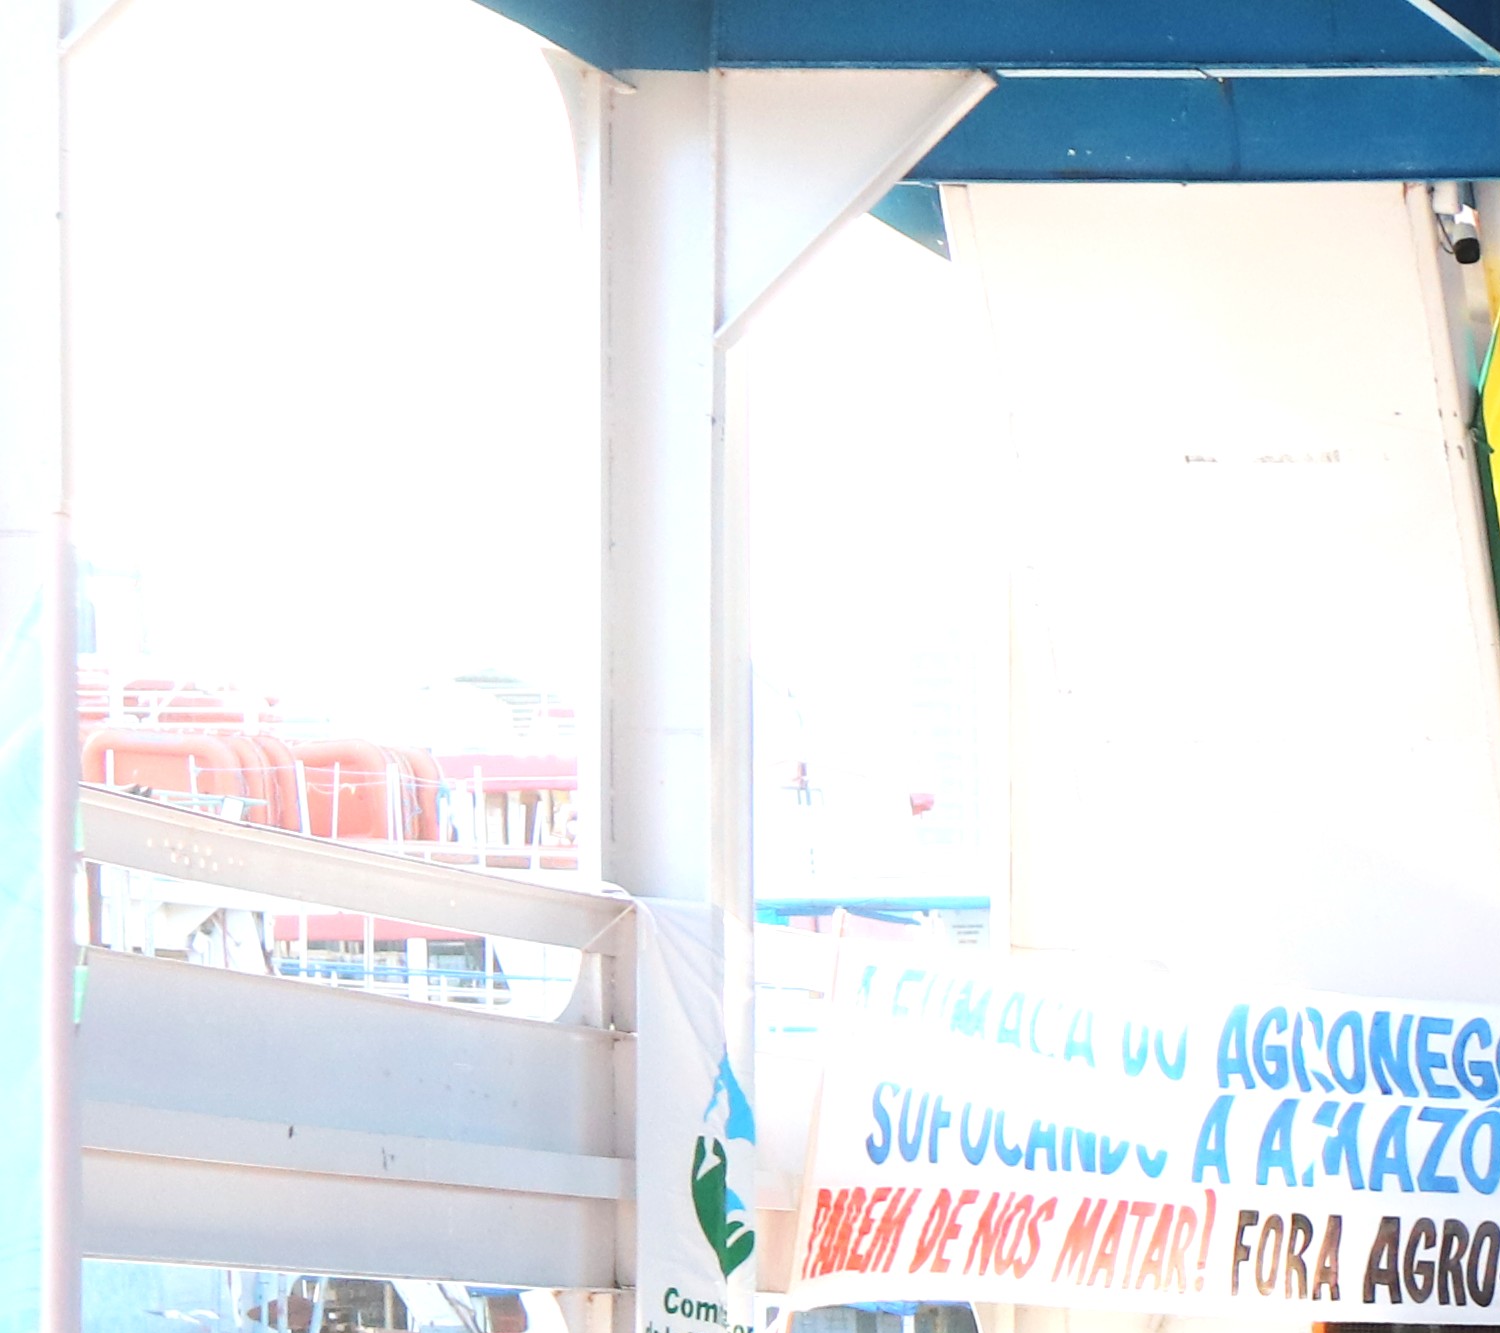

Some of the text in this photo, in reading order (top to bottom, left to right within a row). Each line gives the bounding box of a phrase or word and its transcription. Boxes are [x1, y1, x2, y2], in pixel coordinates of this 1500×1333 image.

[1191, 1094, 1236, 1184] A
[801, 1187, 922, 1281] PAREM
[909, 1187, 979, 1274] DE
[963, 1191, 1058, 1279] NOS
[1052, 1188, 1217, 1294] MATAR!
[1230, 1209, 1343, 1301] FORA
[1362, 1215, 1500, 1308] AGRO
